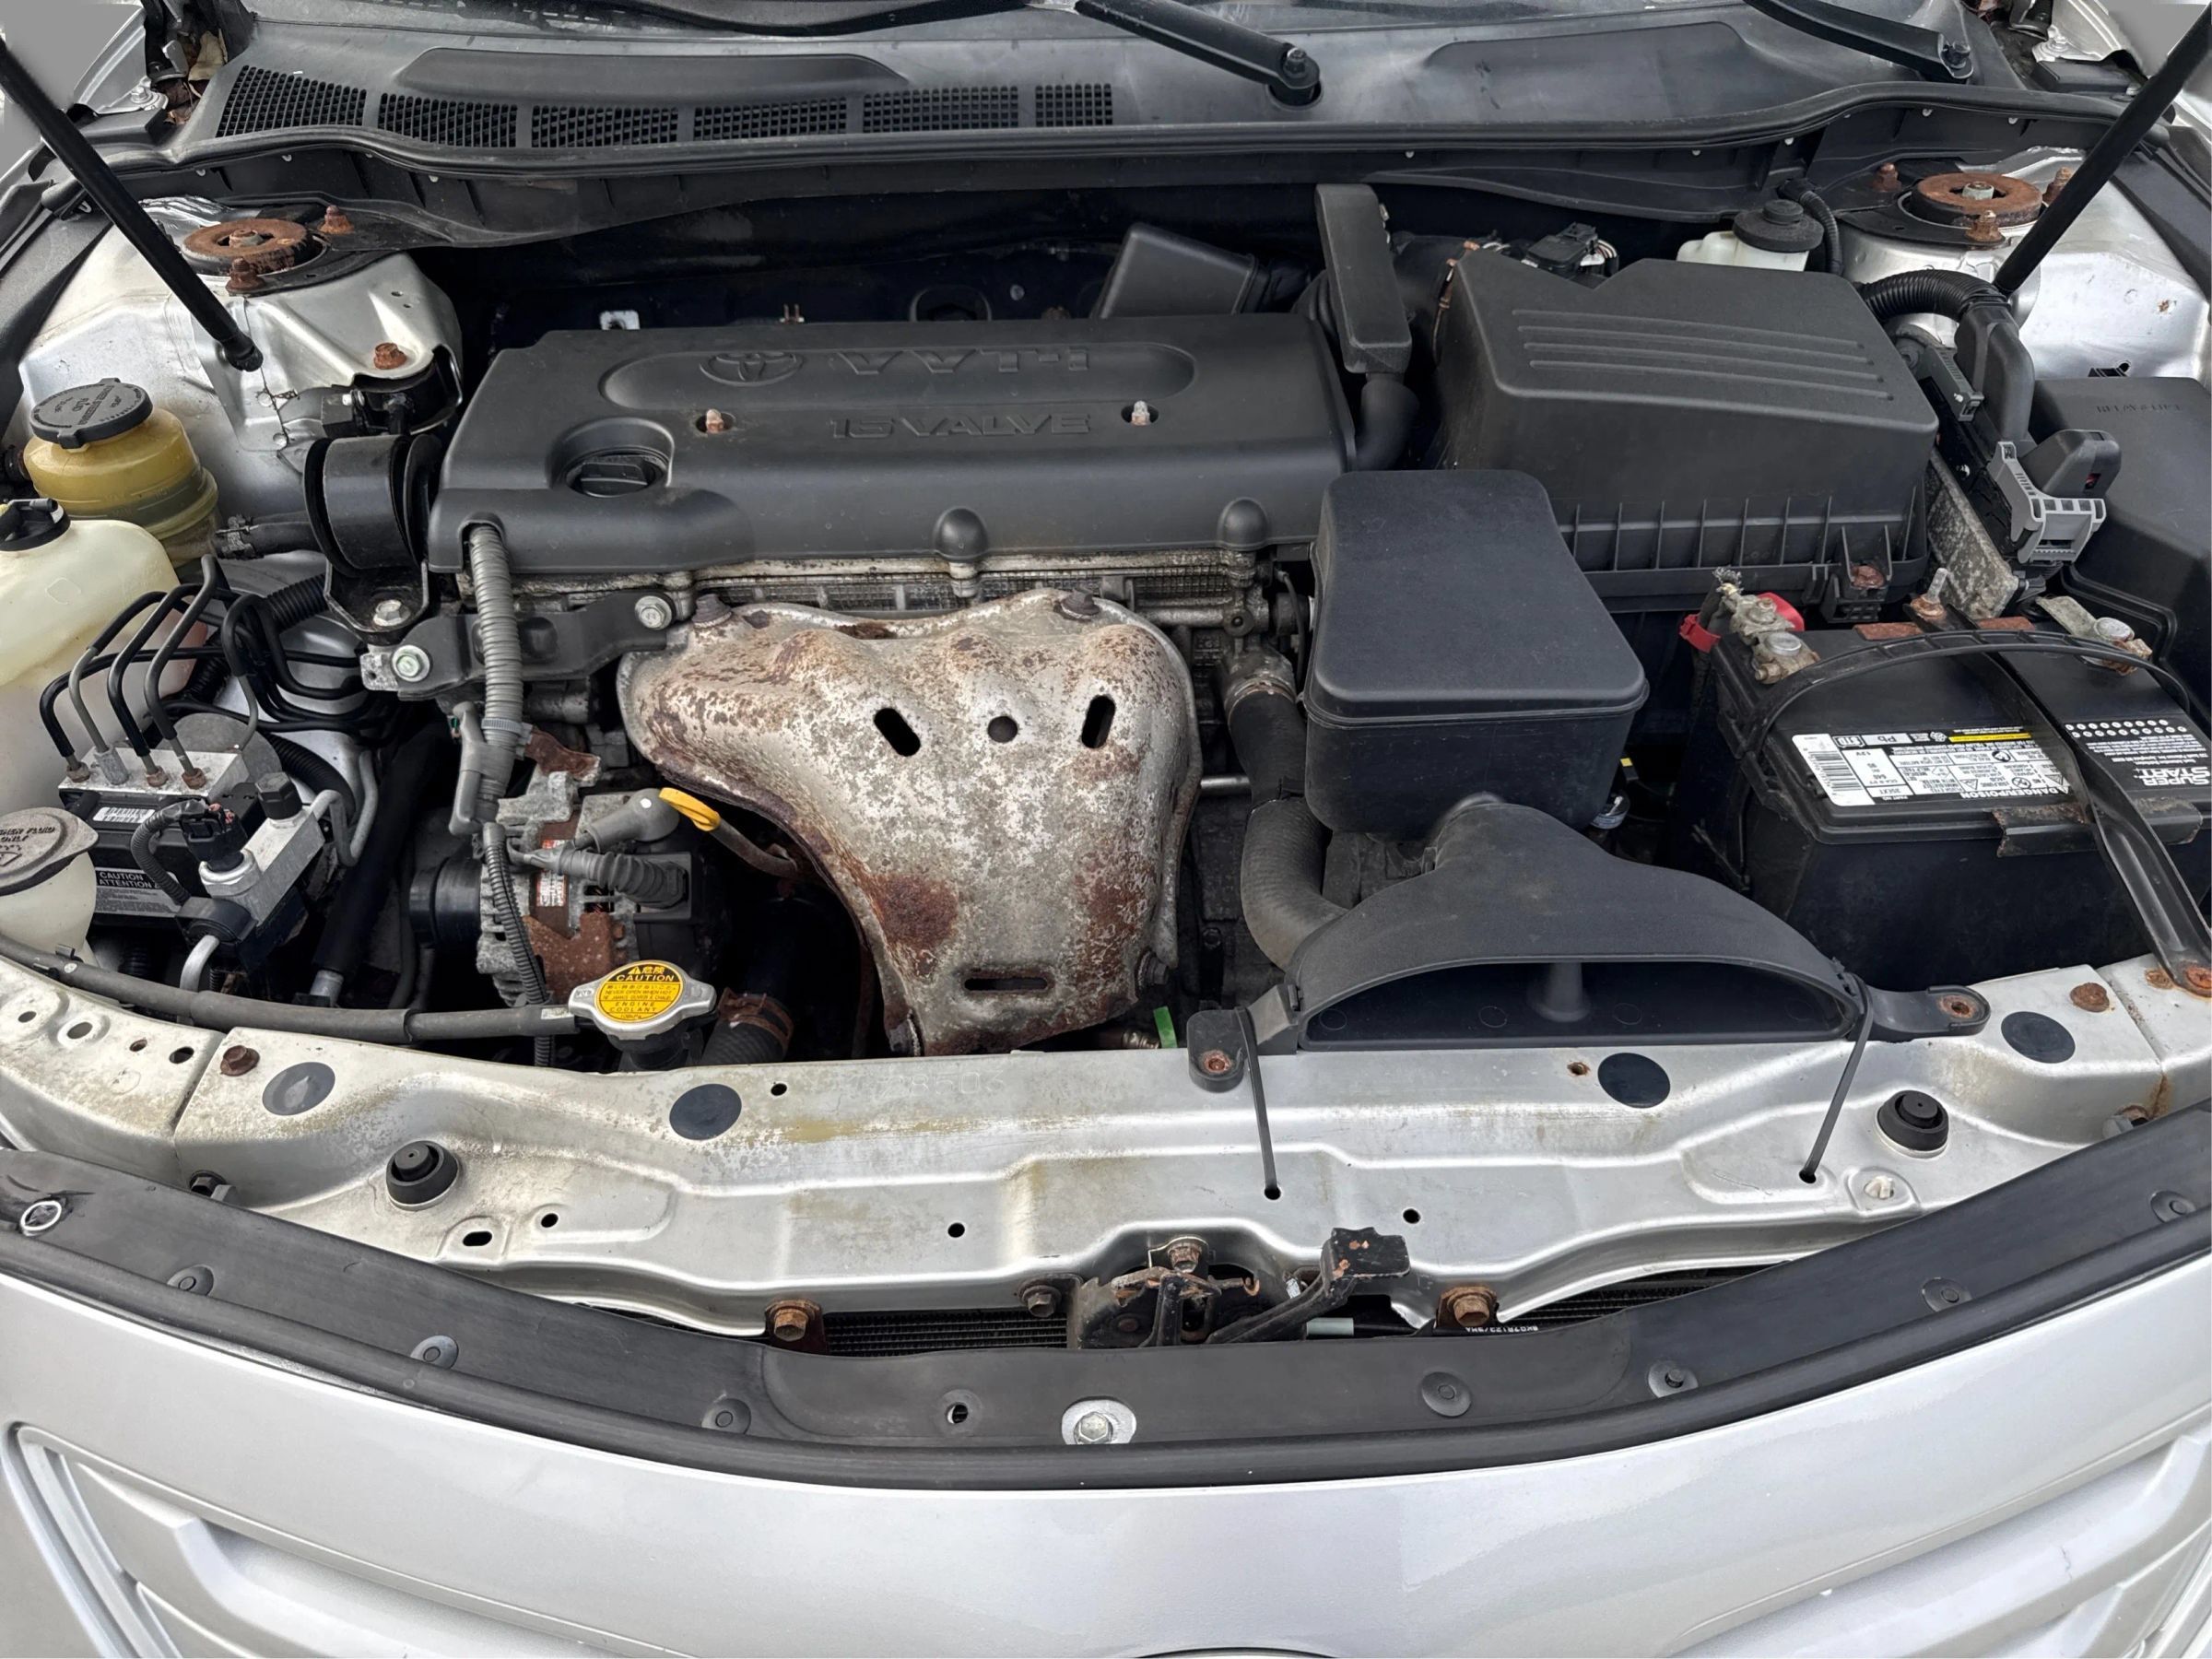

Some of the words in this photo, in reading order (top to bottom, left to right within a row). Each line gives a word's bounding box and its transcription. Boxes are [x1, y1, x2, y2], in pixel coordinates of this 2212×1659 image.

[900, 413, 1092, 438] VALVE
[1877, 735, 1897, 744] Pb
[2136, 766, 2211, 779] START
[2141, 776, 2210, 786] SUPER
[1959, 787, 2059, 798] DANGER/POISON
[100, 871, 144, 881] CAUTION
[99, 878, 152, 888] ATTENTION
